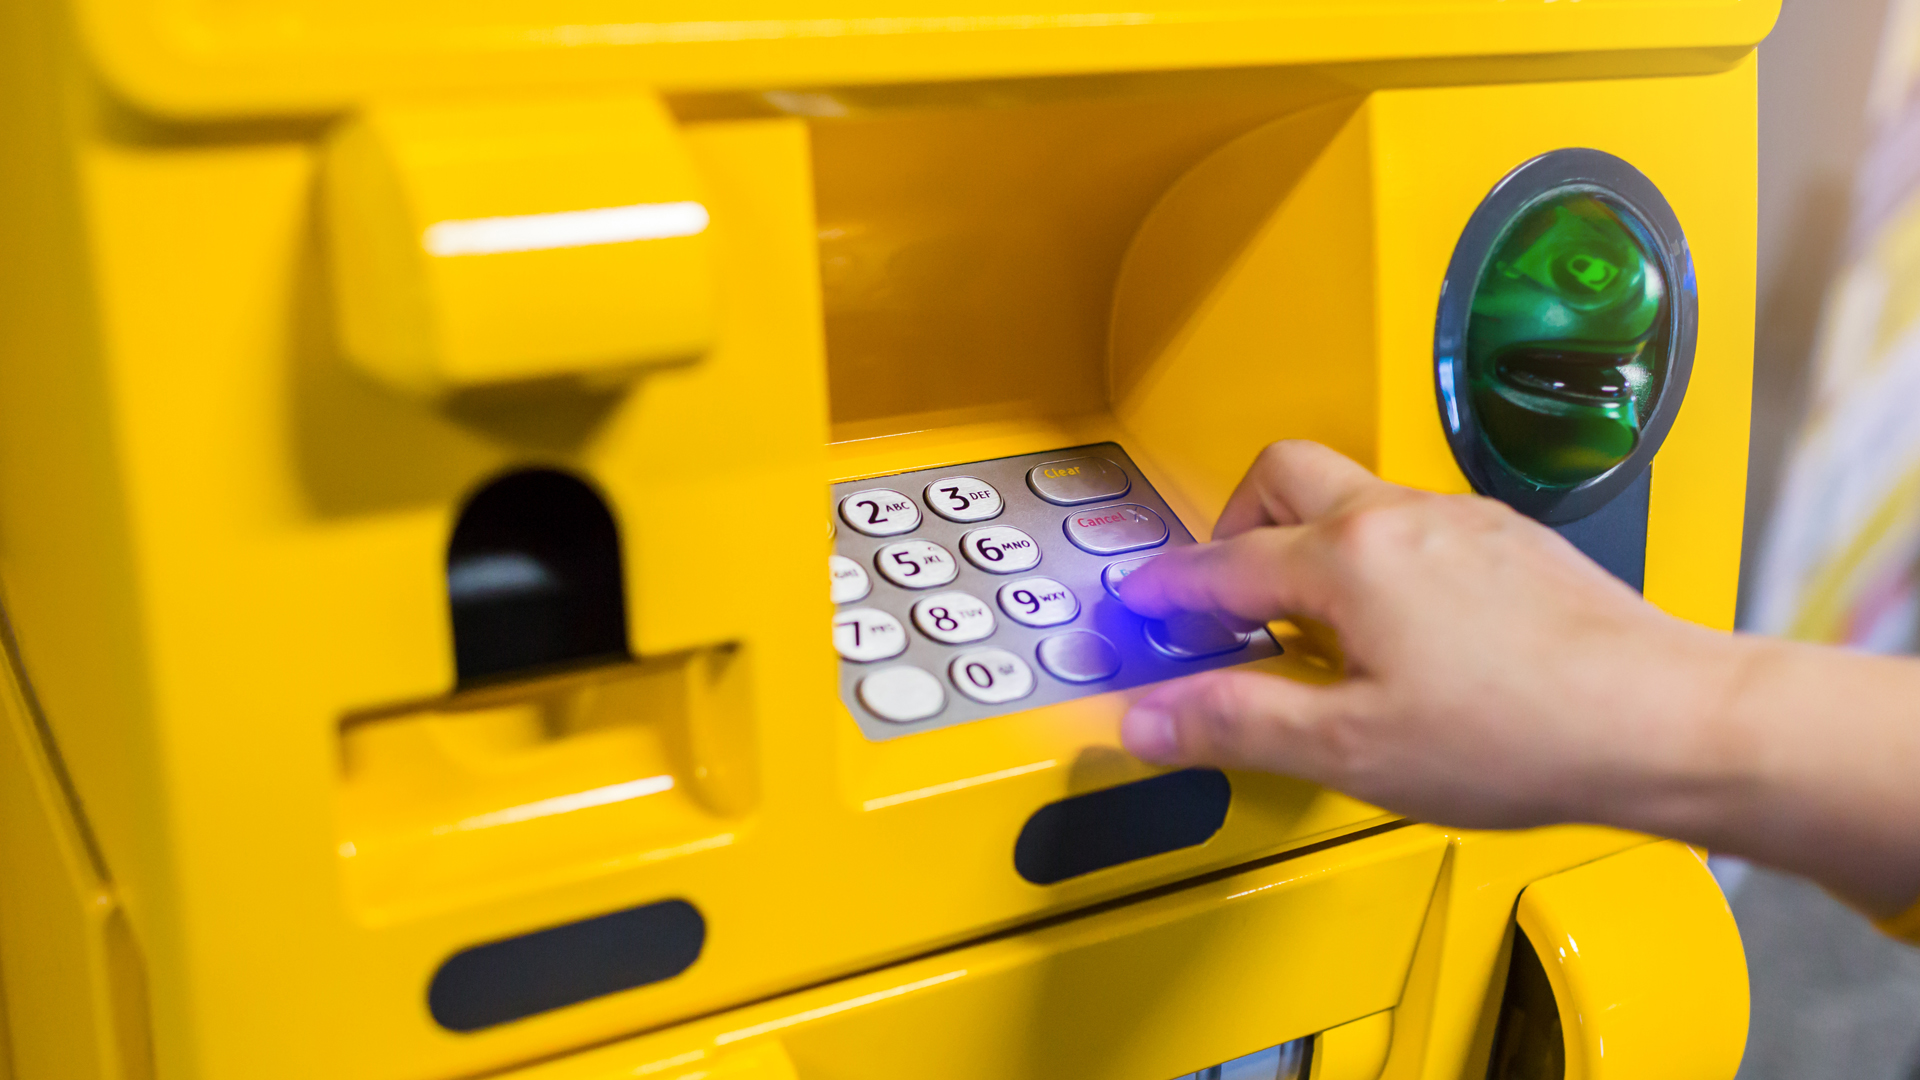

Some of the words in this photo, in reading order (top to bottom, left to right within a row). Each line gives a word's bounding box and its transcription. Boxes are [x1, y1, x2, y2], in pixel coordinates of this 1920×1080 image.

[1044, 465, 1081, 479] Clear
[940, 486, 970, 511] 3
[969, 489, 992, 501] DEF
[856, 500, 888, 525] 2
[885, 501, 910, 513] ABC
[1077, 512, 1127, 528] Cancel
[976, 537, 1004, 562] 6
[1001, 540, 1031, 551] MNO
[892, 551, 921, 576] 5
[923, 555, 944, 565] JKL
[1013, 589, 1040, 614] 9
[1038, 591, 1067, 602] WXY
[929, 607, 958, 631] 8
[834, 621, 860, 646] 7
[966, 663, 993, 689] 0
